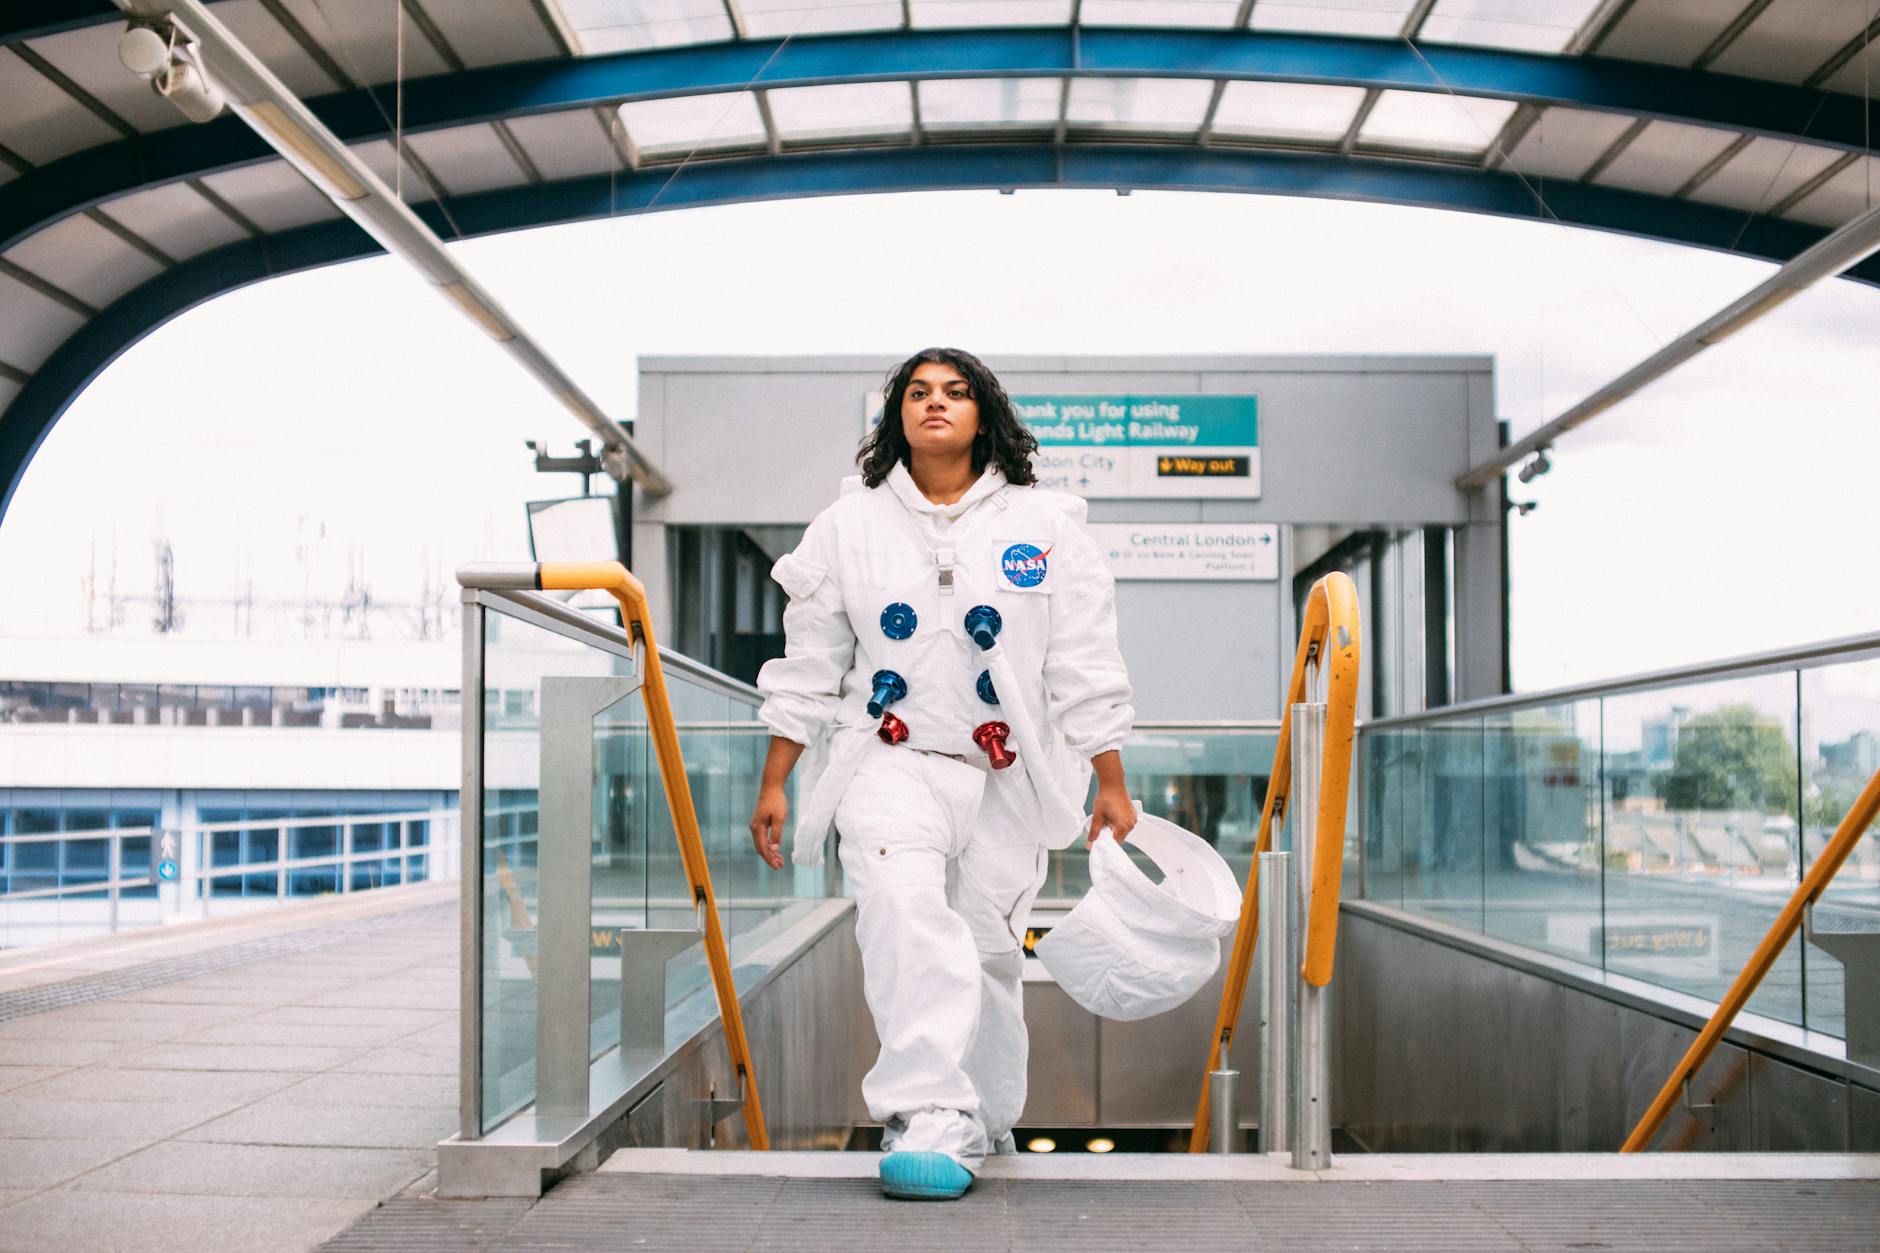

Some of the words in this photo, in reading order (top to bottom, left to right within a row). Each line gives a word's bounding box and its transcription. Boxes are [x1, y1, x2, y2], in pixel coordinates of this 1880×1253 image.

[1014, 401, 1056, 417] hank
[1061, 405, 1095, 421] you
[1099, 401, 1126, 417] for
[1131, 402, 1180, 421] using
[1026, 422, 1075, 438] lands
[1078, 422, 1124, 443] Light
[1129, 422, 1199, 443] Railway
[1079, 453, 1115, 471] City
[1175, 457, 1205, 475] Way
[1209, 459, 1235, 472] out
[1131, 533, 1190, 546] Central
[1196, 533, 1256, 546] London
[1004, 559, 1046, 572] NASA
